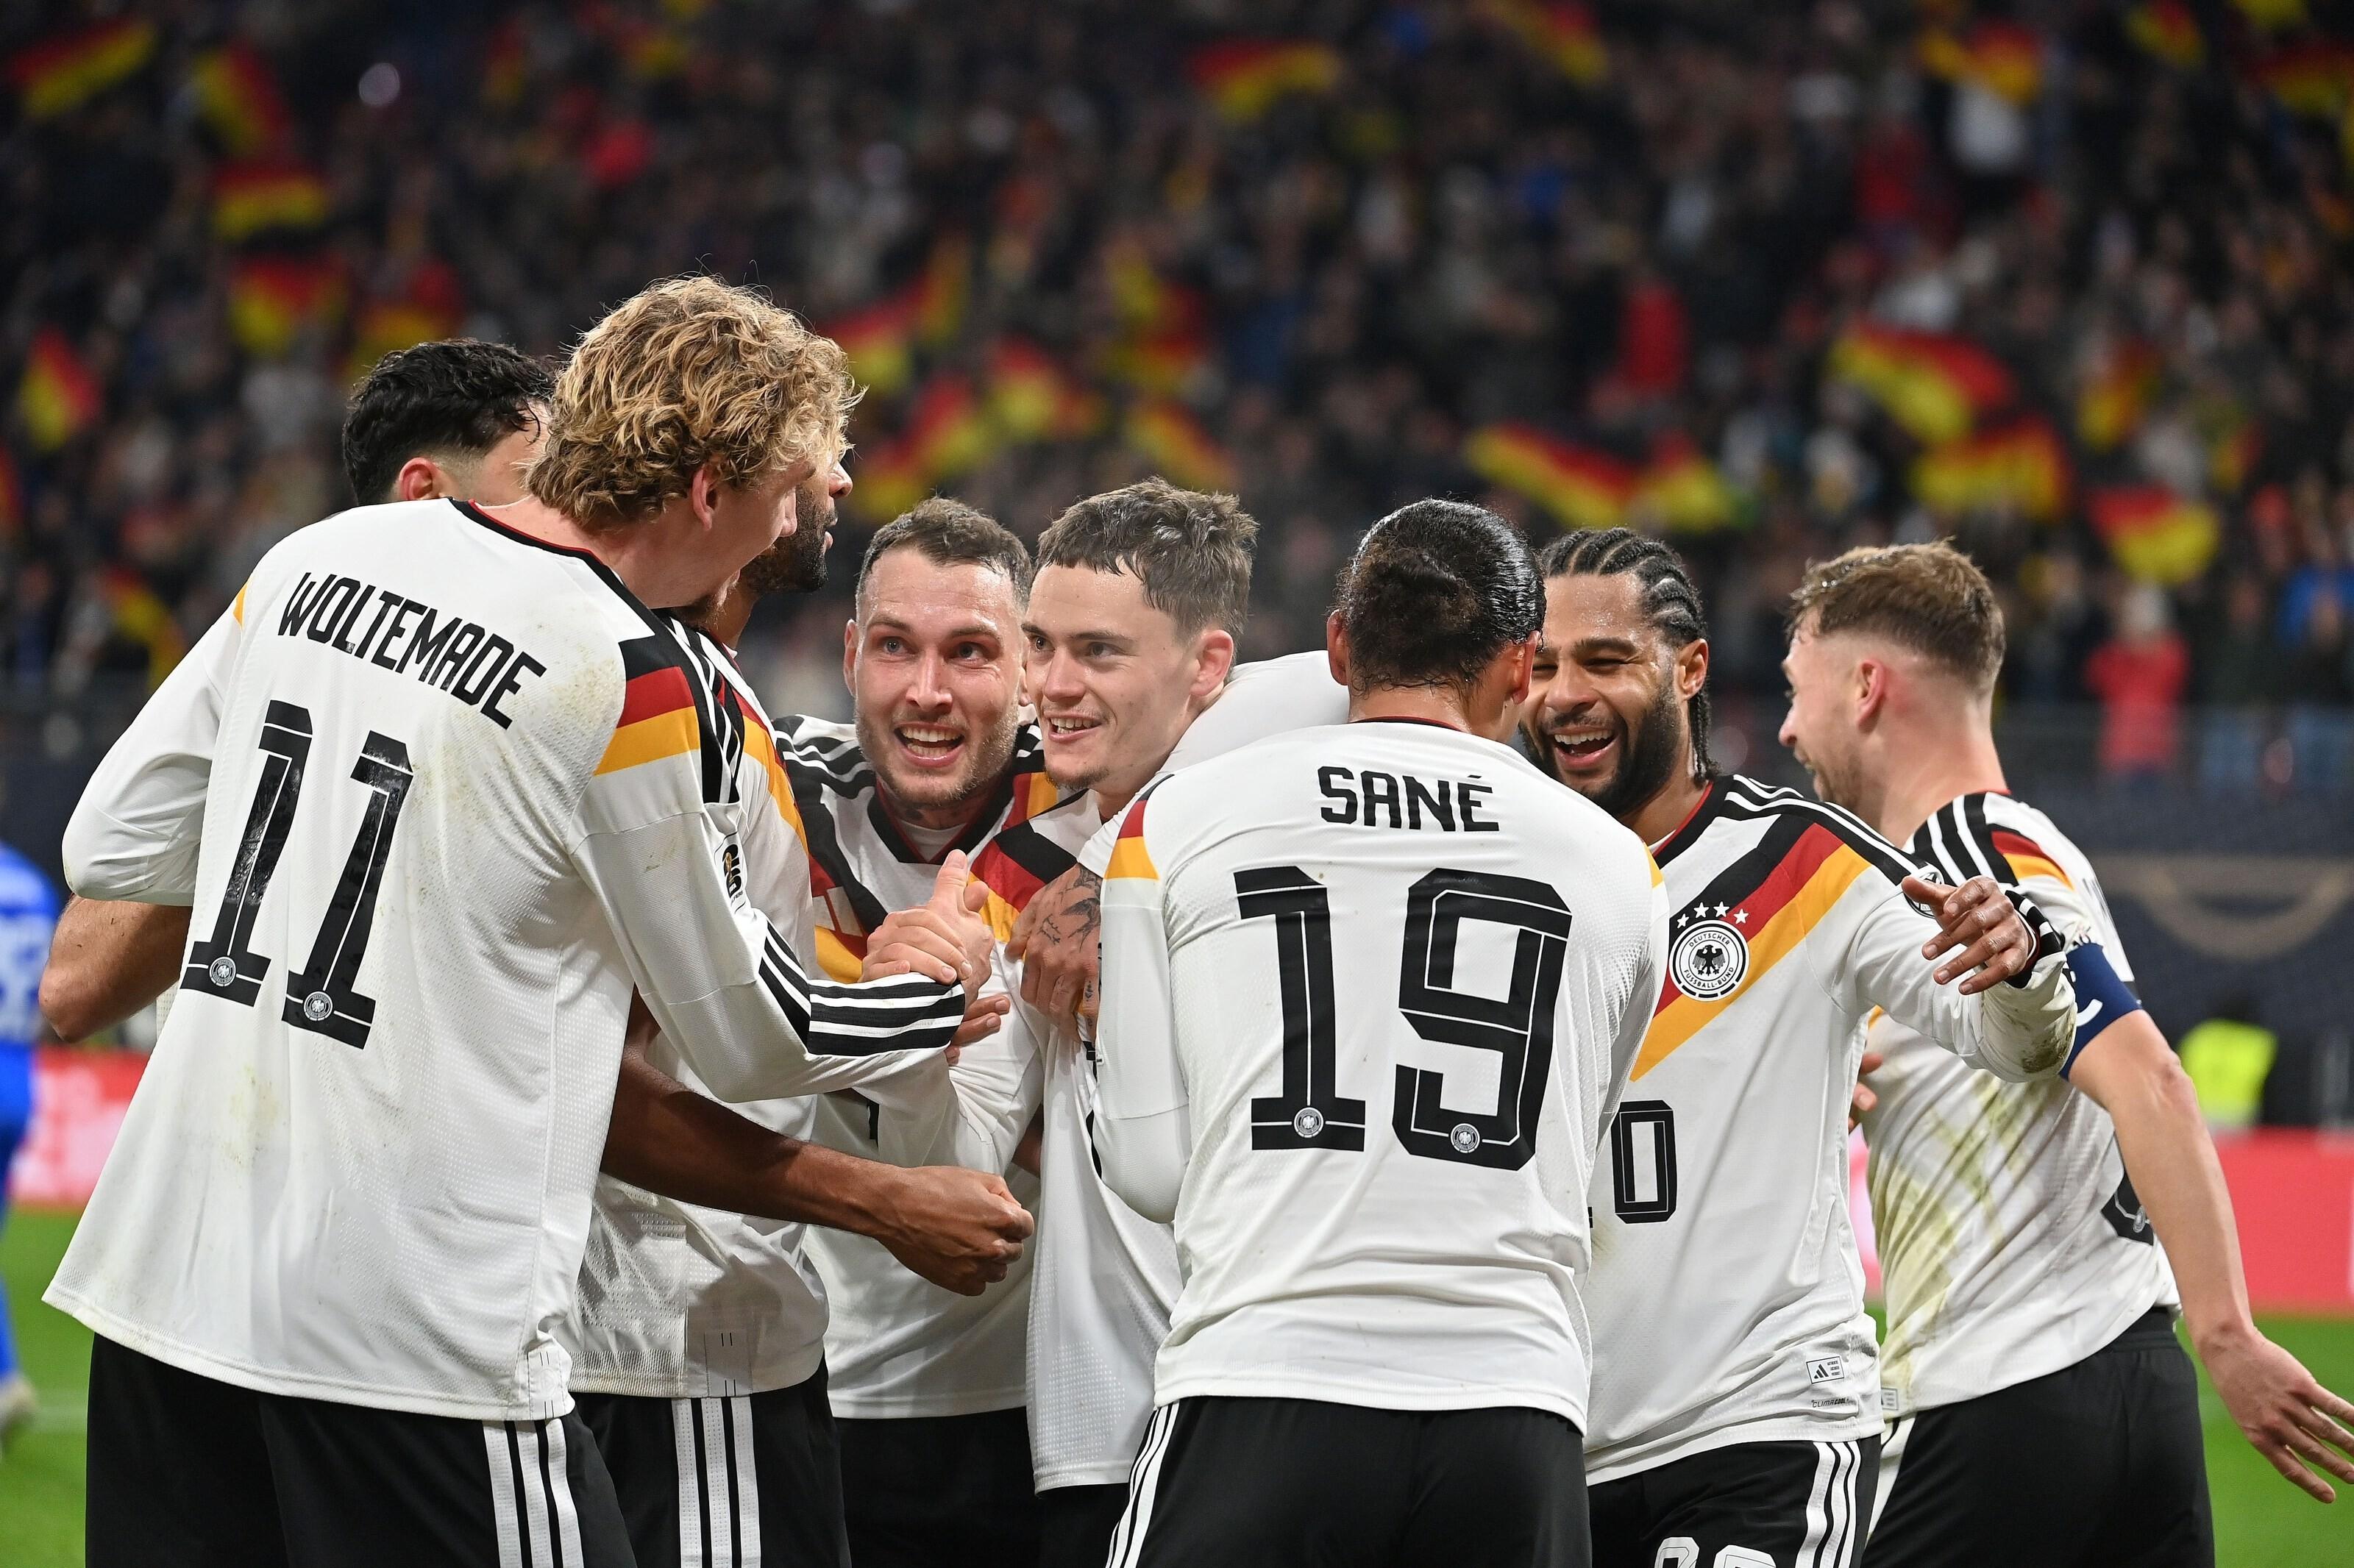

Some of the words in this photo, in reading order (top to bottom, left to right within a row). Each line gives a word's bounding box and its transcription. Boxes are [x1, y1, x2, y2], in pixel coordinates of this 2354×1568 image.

[277, 572, 547, 730] WOLTEMADE
[1318, 766, 1500, 833] SANÉ
[179, 699, 413, 1050] 11
[1683, 966, 1734, 988] FUSSBALL-BUND
[1689, 933, 1730, 948] DEUTSCHER
[1233, 865, 1573, 1172] 19
